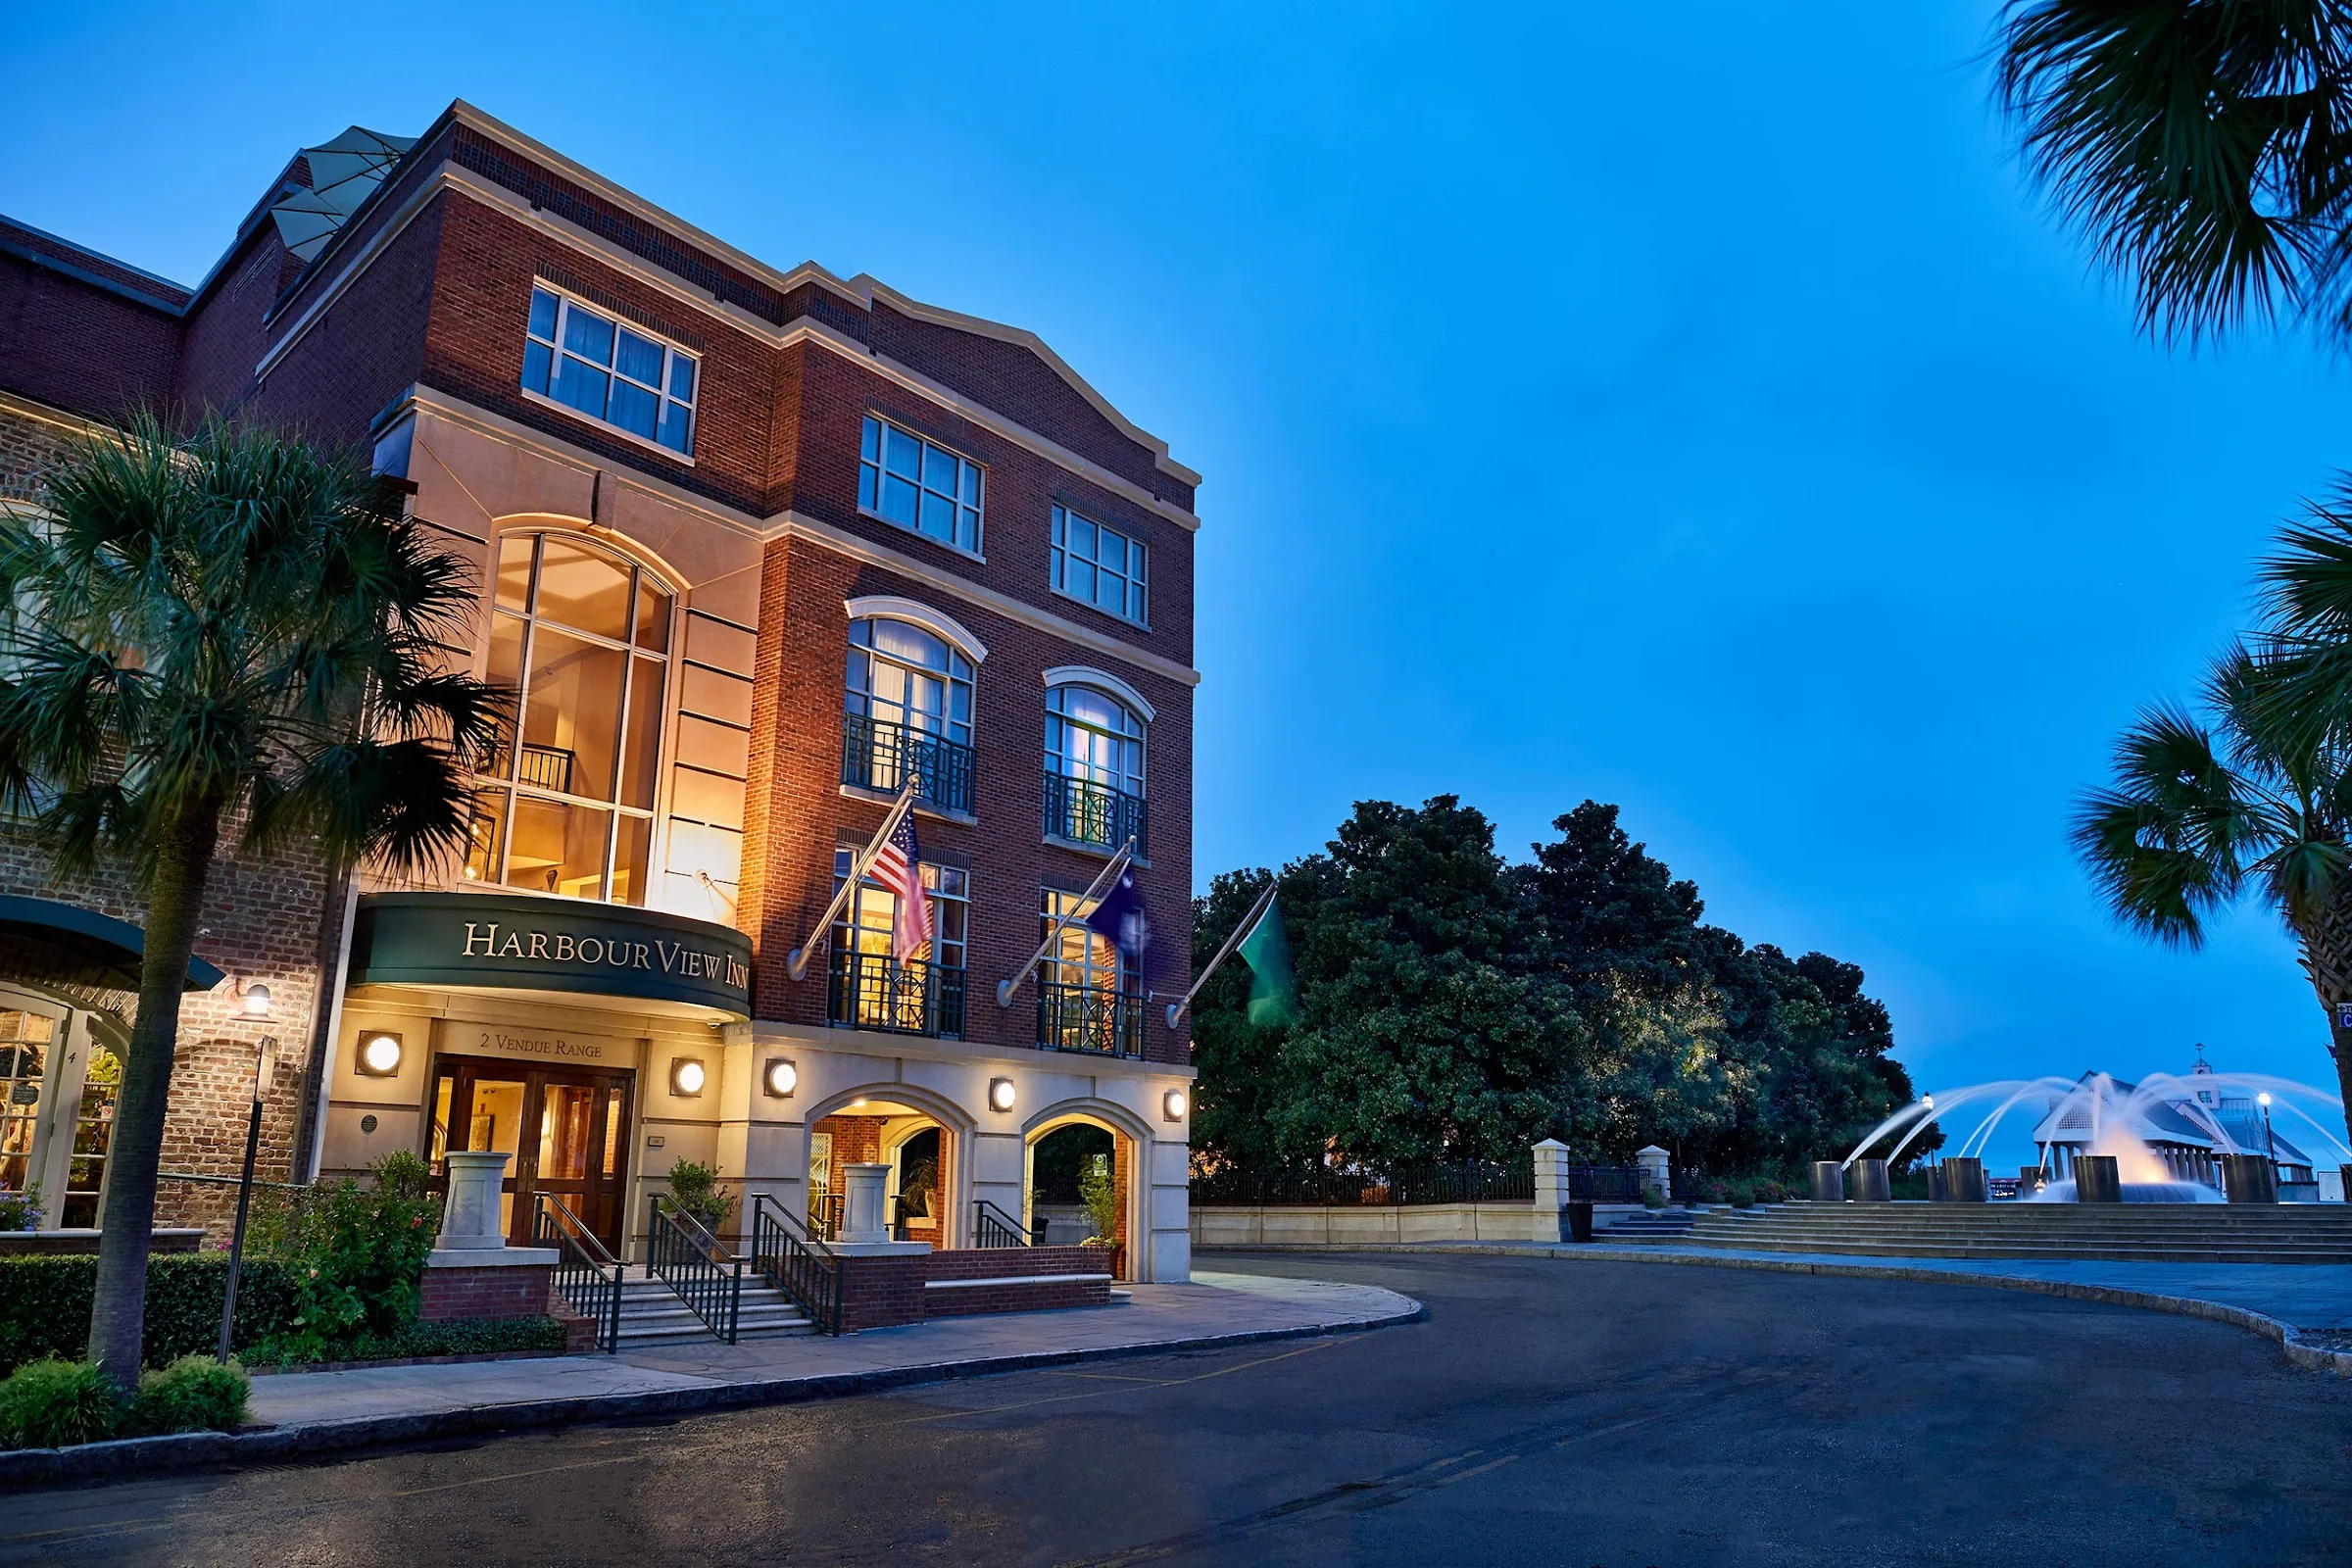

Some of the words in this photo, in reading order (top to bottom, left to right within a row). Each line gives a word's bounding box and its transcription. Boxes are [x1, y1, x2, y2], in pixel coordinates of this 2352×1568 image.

[724, 954, 750, 990] INN
[479, 1032, 490, 1048] 2
[495, 1034, 552, 1054] VENDUE
[555, 1040, 603, 1058] RANGE
